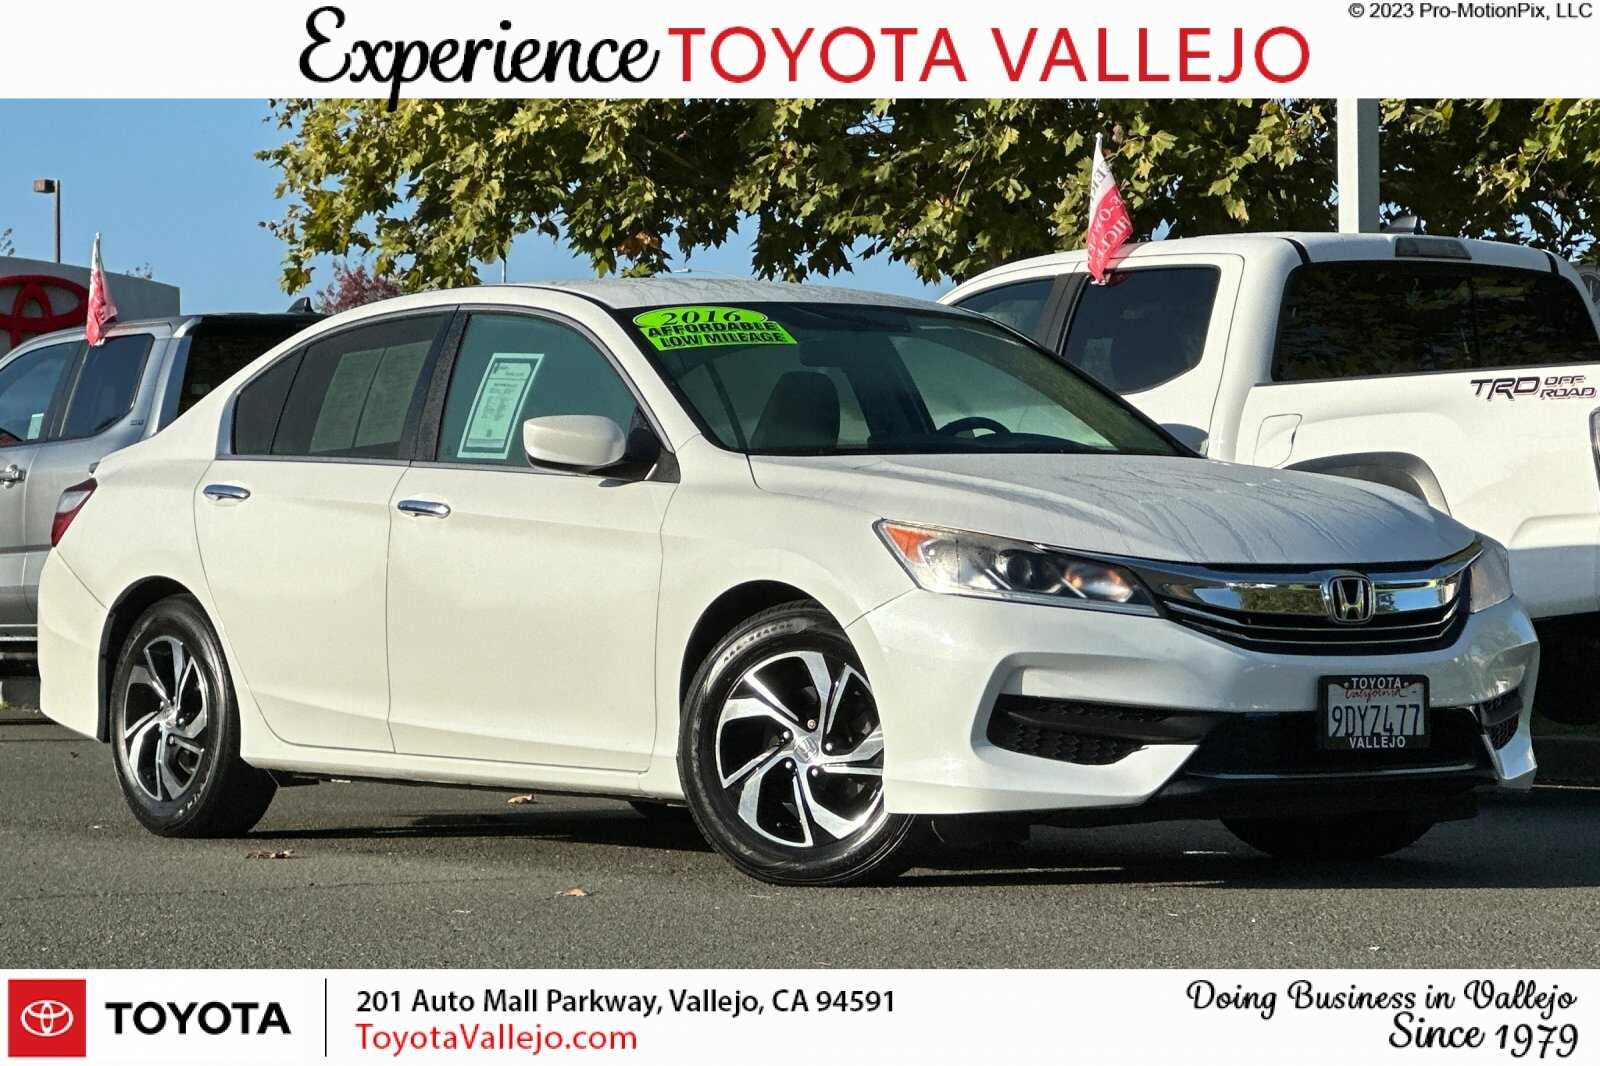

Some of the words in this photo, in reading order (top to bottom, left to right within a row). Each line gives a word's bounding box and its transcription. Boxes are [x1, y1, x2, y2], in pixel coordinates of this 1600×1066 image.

[660, 310, 742, 325] 2016
[648, 321, 782, 338] AFFORDABLE
[659, 333, 700, 348] LOW
[704, 331, 785, 345] MILEAGE
[1470, 376, 1540, 400] TRD
[1544, 375, 1586, 386] OFF
[1540, 387, 1597, 399] ROAD
[1351, 677, 1401, 689] TOYOTA
[1344, 688, 1409, 703] California
[1331, 703, 1420, 738] 9DYZ477
[1349, 736, 1406, 748] VALLEJO
